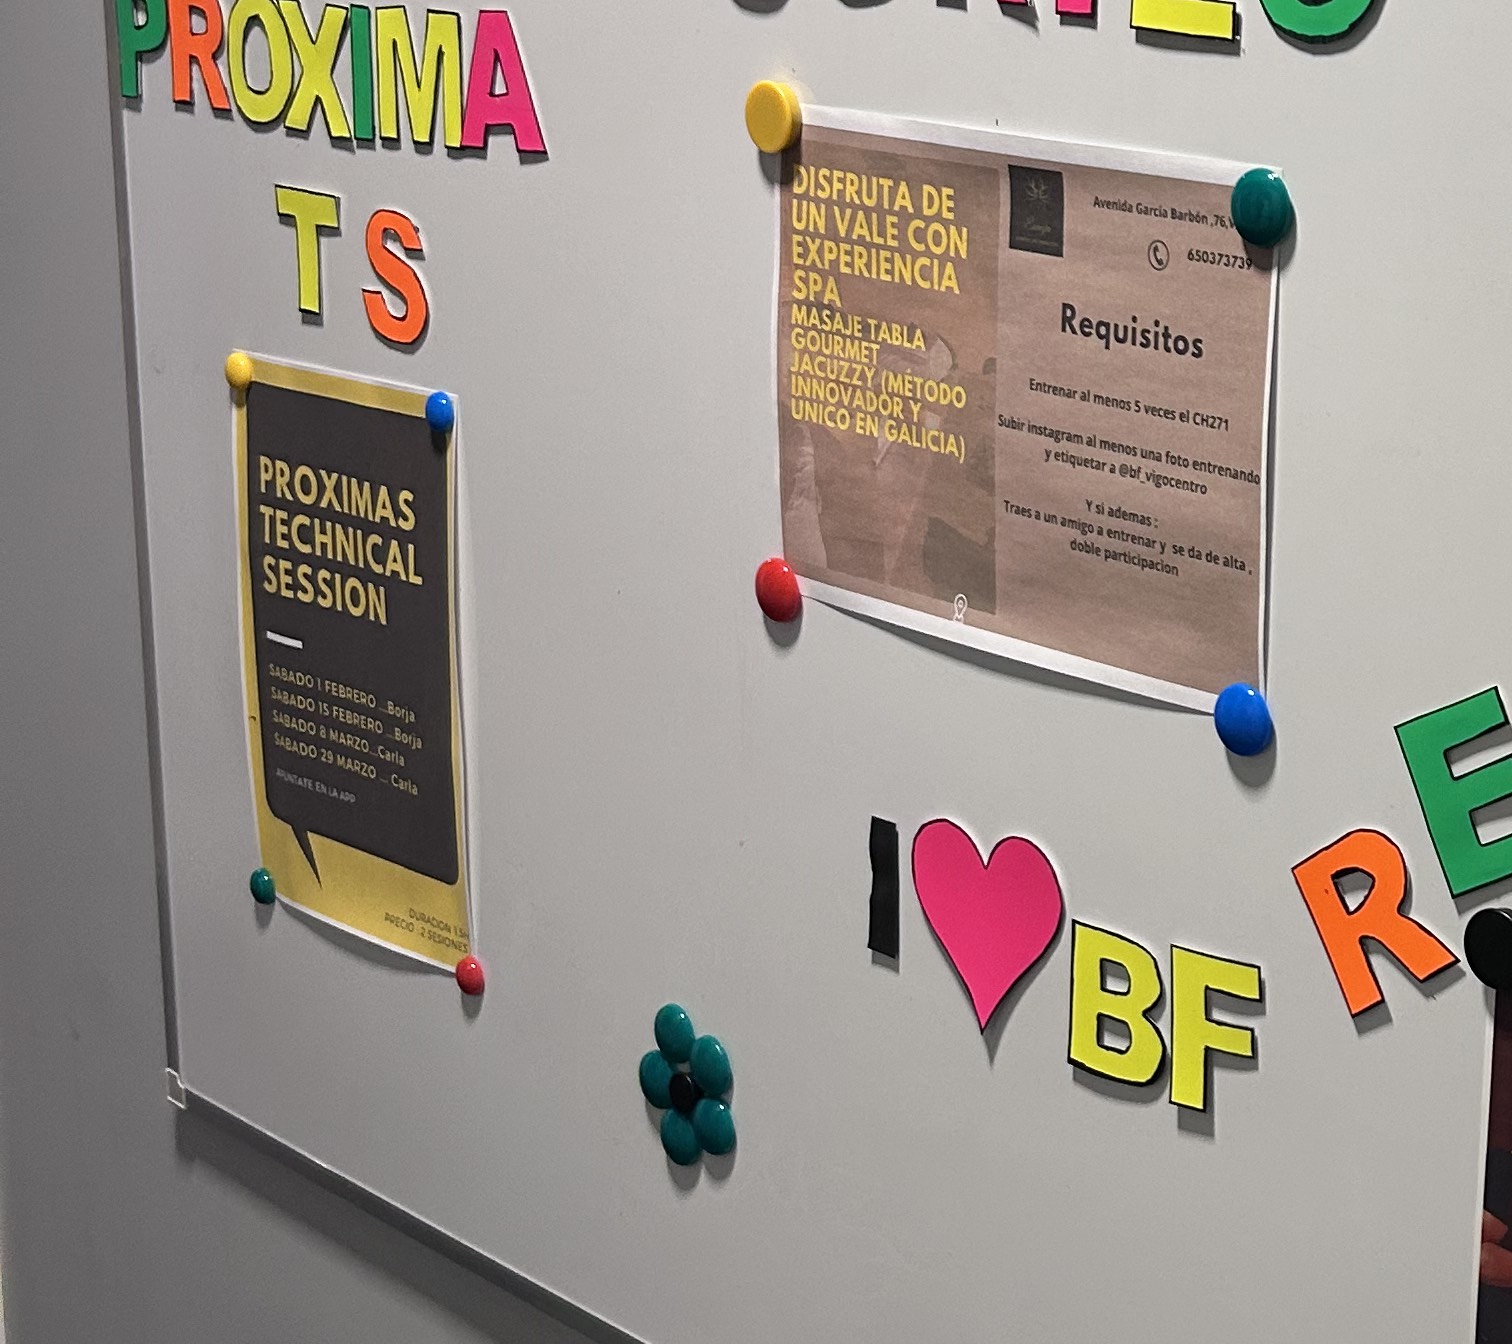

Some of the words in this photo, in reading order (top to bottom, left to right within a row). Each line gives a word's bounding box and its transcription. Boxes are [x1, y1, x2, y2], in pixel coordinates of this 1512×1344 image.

[793, 165, 913, 214] DISFRUTA
[922, 184, 955, 220] DE
[792, 199, 825, 234] UN
[834, 205, 899, 248] VALE
[907, 219, 968, 259] CON
[792, 234, 960, 294] EXPERIENCIA
[1187, 248, 1252, 270] 650373739
[792, 270, 842, 307] SPA
[791, 328, 880, 364] GOURMET
[792, 304, 861, 338] MASAJE
[868, 318, 925, 351] TABLA
[1060, 302, 1204, 358] Requisitos
[791, 353, 876, 387] JACUZZY
[881, 368, 966, 408] (MÉTODO
[792, 376, 904, 419] INNOVADOR
[910, 403, 922, 421] Y
[1029, 378, 1077, 401] Entrenar
[1080, 389, 1090, 402] al
[1094, 394, 1131, 412] menos
[1134, 400, 1141, 413] 5
[1144, 404, 1176, 420] veces
[1179, 410, 1189, 422] el
[1193, 413, 1229, 431] CH271
[792, 399, 850, 430] UNICO
[856, 413, 878, 438] EN
[885, 420, 965, 464] GALICIA)
[998, 414, 1025, 432] Subir
[1028, 421, 1083, 445] instagram
[1086, 435, 1096, 448] al
[1100, 439, 1137, 457] menos
[1140, 448, 1162, 461] una
[1165, 451, 1189, 468] foto
[1192, 460, 1261, 485] entrenando
[260, 455, 416, 531] PROXIMAS
[1044, 449, 1051, 463] y
[1054, 450, 1106, 473] etiquetar
[1110, 464, 1116, 474] a
[1119, 464, 1207, 495] @bf_vigocentro
[259, 504, 423, 585] TECHNICAL
[1003, 500, 1032, 519] Traes
[1034, 510, 1041, 521] a
[1044, 513, 1057, 524] un
[1060, 515, 1094, 536] amigo
[1097, 526, 1103, 536] a
[1107, 528, 1156, 549] entrenar
[1159, 541, 1166, 554] y
[1172, 544, 1185, 556] se
[1188, 546, 1201, 560] da
[1206, 551, 1220, 565] de
[1223, 555, 1246, 572] alta
[1070, 538, 1100, 556] doble
[1104, 548, 1179, 576] participacion
[263, 555, 387, 625] SESSION
[269, 663, 314, 688] SABADO
[317, 677, 321, 690] 1
[325, 680, 376, 708] FEBRERO
[274, 732, 317, 758] SABADO
[321, 748, 334, 764] 29
[337, 754, 376, 779] MARZO
[391, 774, 418, 796] Carla
[868, 815, 899, 959] I
[1067, 919, 1262, 1113] BF
